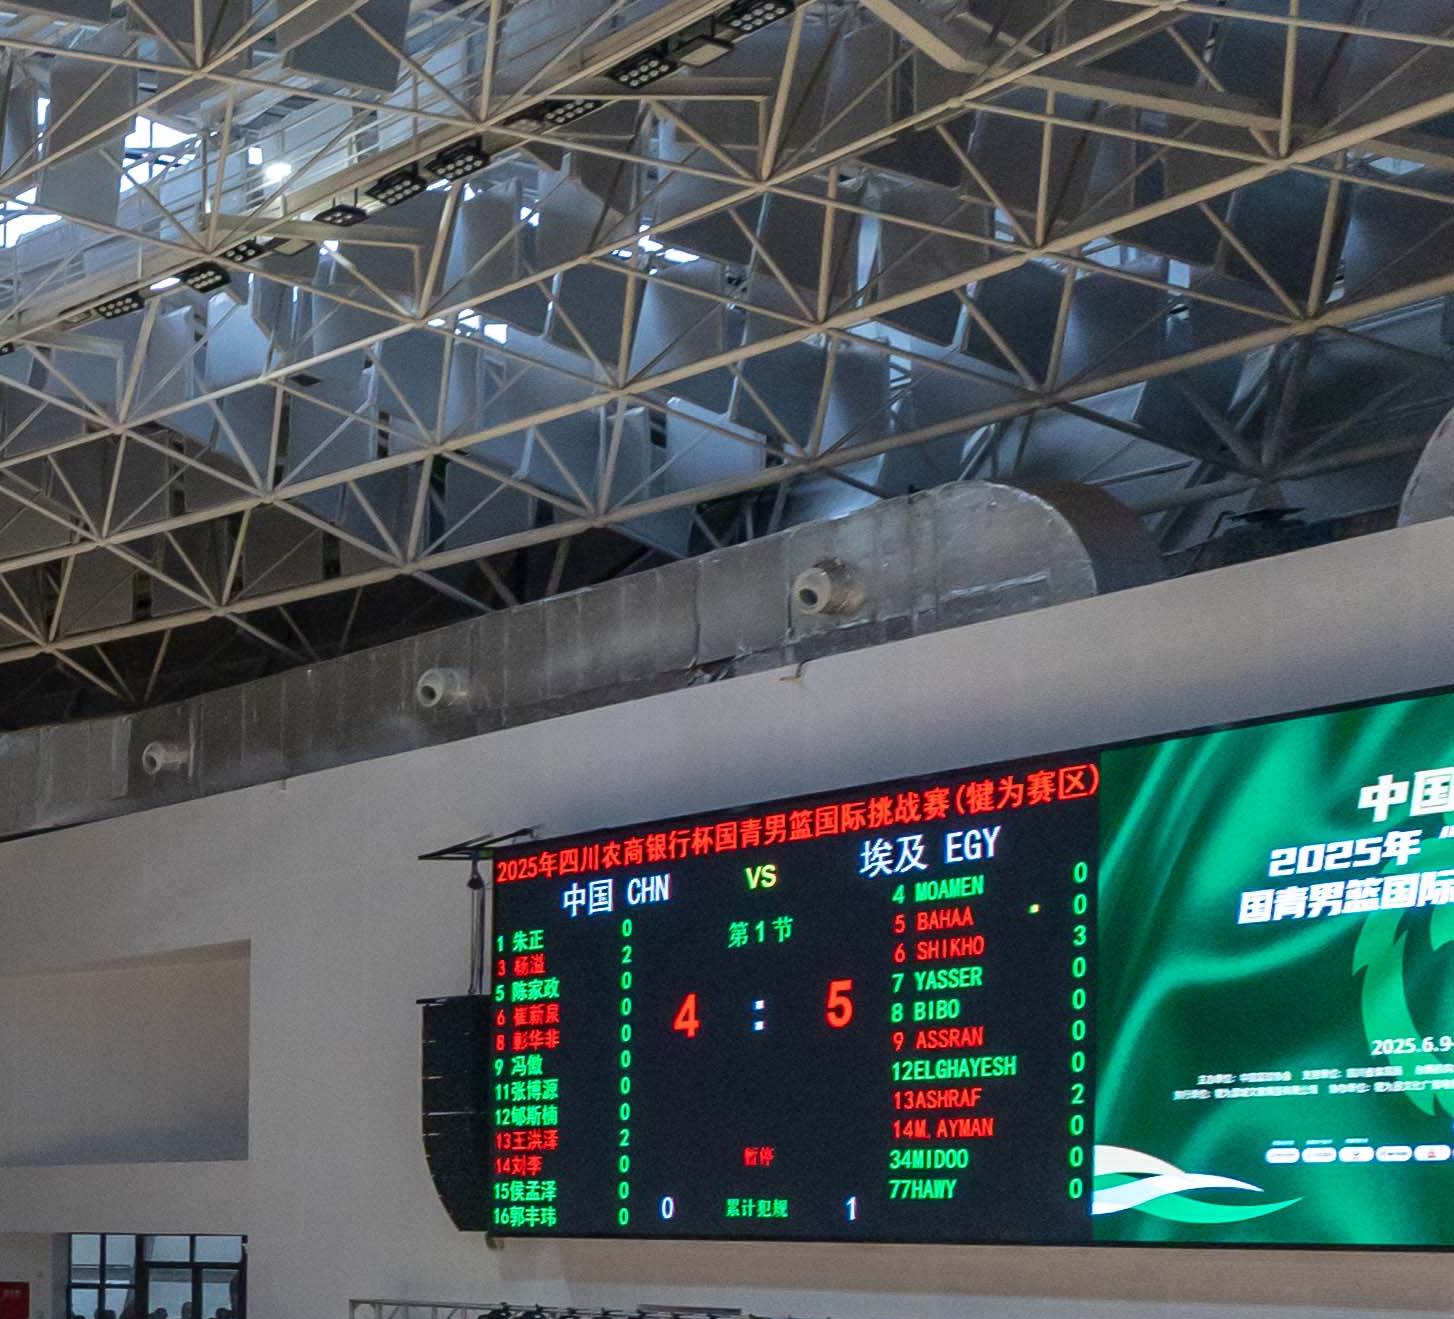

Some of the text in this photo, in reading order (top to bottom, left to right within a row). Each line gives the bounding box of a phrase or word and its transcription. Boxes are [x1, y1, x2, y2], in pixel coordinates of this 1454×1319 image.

[859, 826, 1001, 879] 埃及 EGY
[744, 864, 778, 889] VS
[893, 861, 1088, 904] 4 MOAMEN 0
[562, 873, 670, 917] 中国 CHN
[894, 893, 1087, 934] 5 BAHAA 0
[497, 918, 633, 952] 1 朱正 0
[894, 924, 1087, 964] 6 SHIKHO 3
[497, 959, 506, 977] 3
[621, 945, 633, 964] 2
[495, 985, 505, 1002] 5
[621, 971, 632, 990] 0
[892, 956, 1087, 993] 7 YASSER 0
[496, 1009, 506, 1027] 6
[621, 998, 632, 1016] 0
[673, 993, 700, 1038] 4
[825, 978, 854, 1029] 5
[891, 989, 1086, 1022] 8 BIBO 0
[495, 1034, 505, 1052] 8
[621, 1024, 632, 1042] 0
[892, 1019, 1086, 1051] 9 ASSRAN 0
[494, 1058, 504, 1076] 9
[620, 1050, 631, 1068] 0
[1071, 1051, 1086, 1073] 0
[620, 1076, 631, 1095] 0
[1071, 1083, 1086, 1105] 2
[619, 1102, 630, 1121] 0
[619, 1128, 630, 1147] 2
[1070, 1114, 1085, 1136] 0
[619, 1155, 630, 1173] 0
[1069, 1146, 1084, 1167] 0
[618, 1181, 629, 1199] 0
[1069, 1178, 1083, 1200] 0
[618, 1207, 629, 1226] 0
[661, 1196, 675, 1219] 0
[725, 1198, 789, 1219] 累计犯规
[845, 1196, 858, 1221] 1
